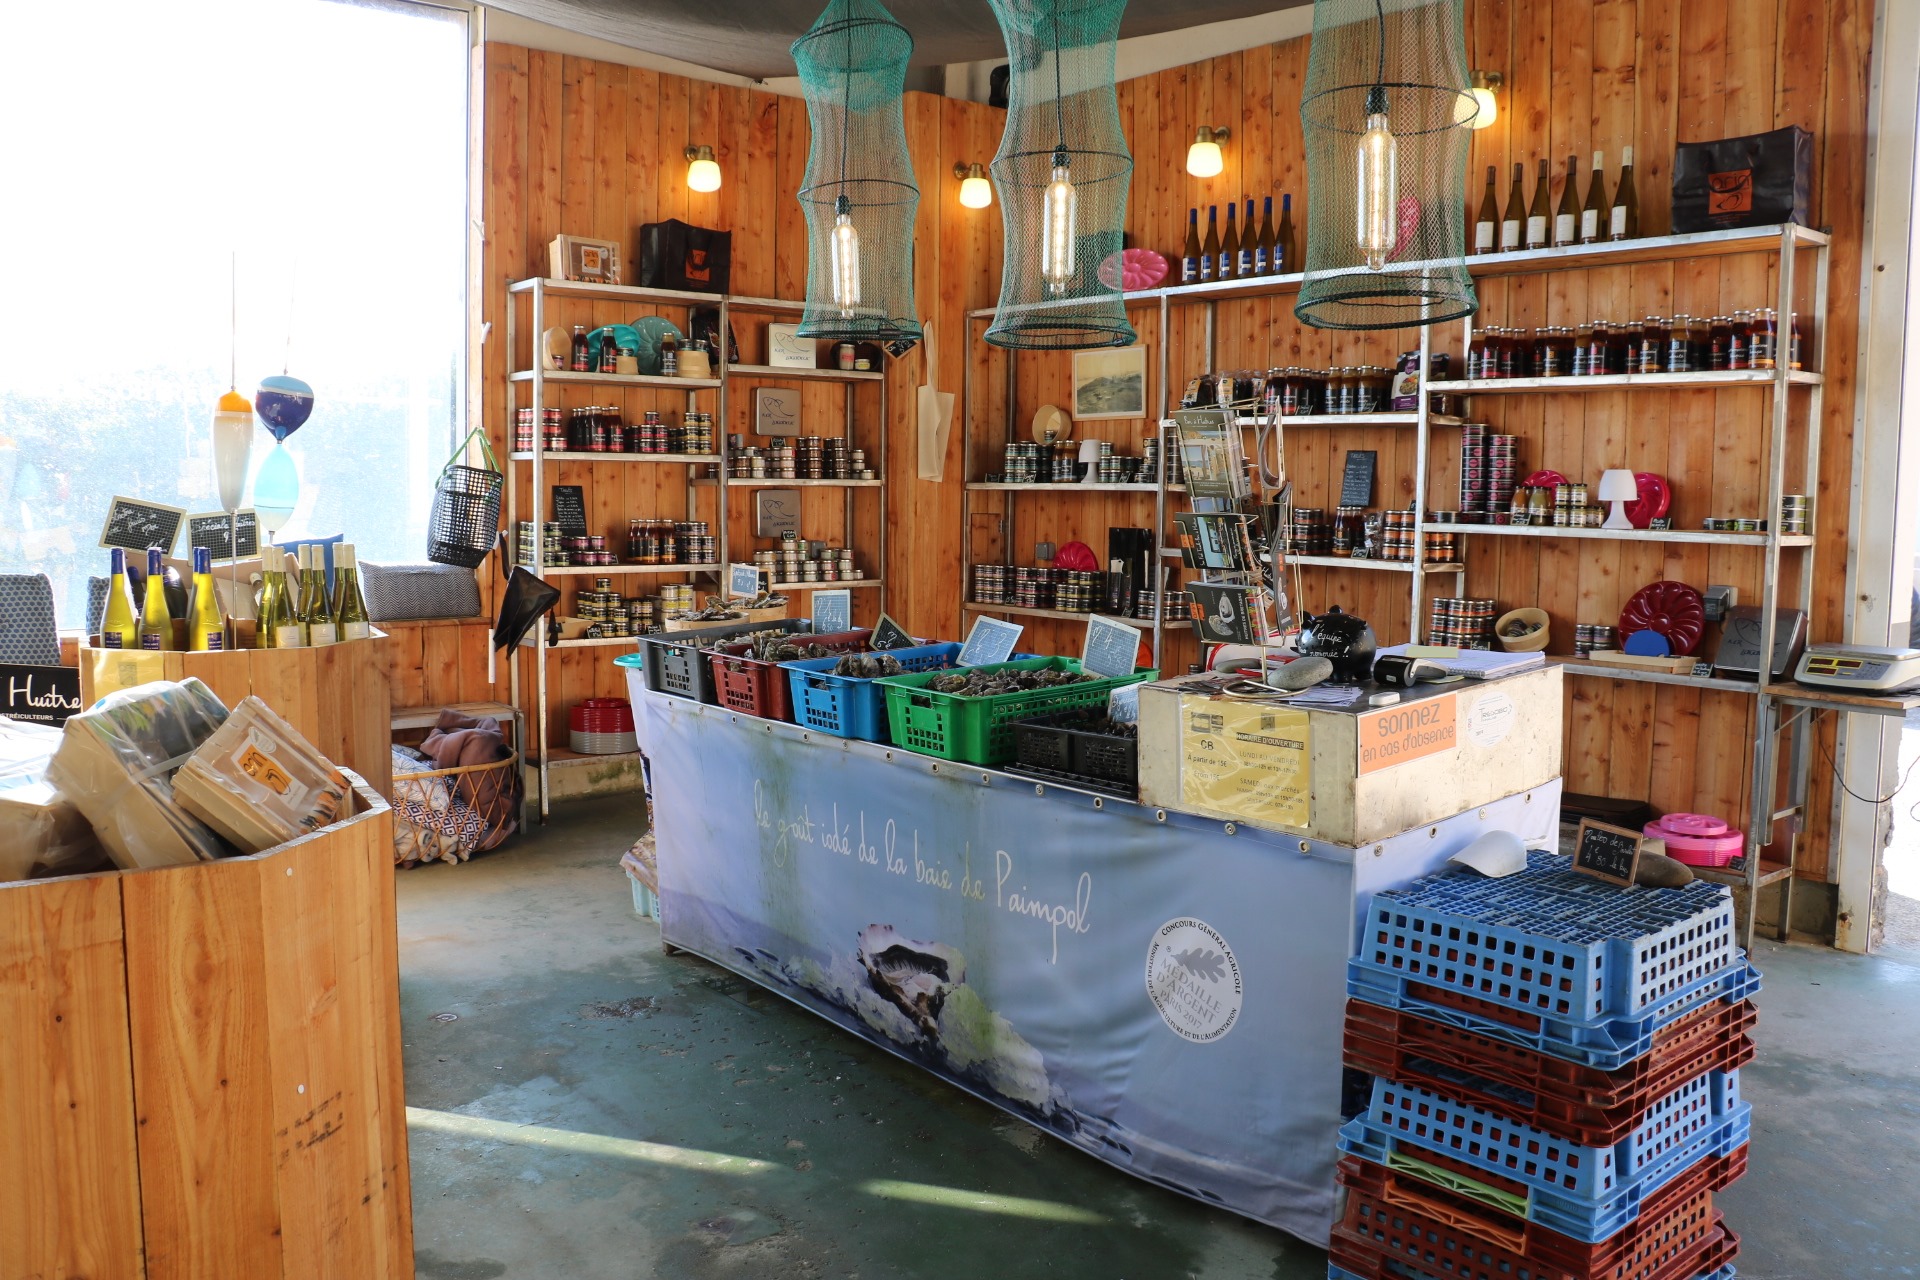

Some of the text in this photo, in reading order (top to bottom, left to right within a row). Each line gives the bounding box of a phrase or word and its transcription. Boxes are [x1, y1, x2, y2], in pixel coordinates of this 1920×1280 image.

[1378, 703, 1441, 738] sonnez
[1200, 739, 1214, 751] CB
[1236, 732, 1304, 749] HORAIRE D'OUVERTURE
[1239, 751, 1258, 760] LUNDI
[1363, 725, 1454, 763] en cas d'absence
[1193, 756, 1208, 764] partir
[1209, 757, 1216, 765] de
[755, 779, 1092, 965] le goût iodé de la baie de Paimpol
[1161, 920, 1241, 995] CONCOURS GÉNÉRAL AGRICOLE
[1157, 971, 1216, 1024] D'ARGENT
[1161, 957, 1222, 1014] MÉDAILLE
[1150, 990, 1183, 1035] L'AGRICULTURE
[1184, 1030, 1191, 1038] ET
[1201, 1007, 1237, 1040] L'ALIMENTATION
[1160, 990, 1203, 1030] PARIS 2017
